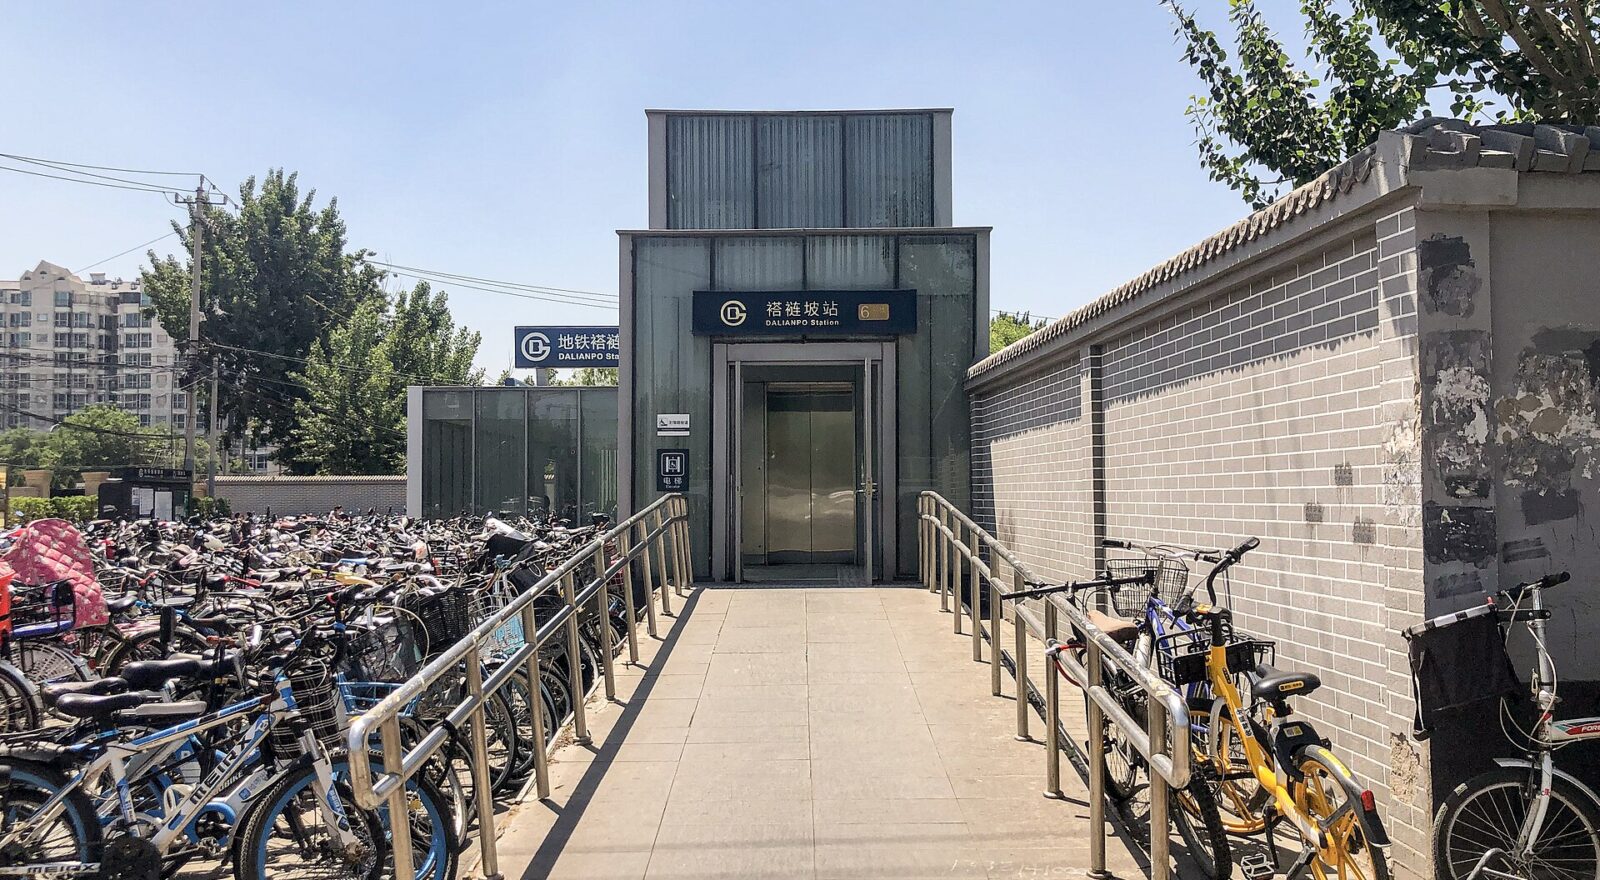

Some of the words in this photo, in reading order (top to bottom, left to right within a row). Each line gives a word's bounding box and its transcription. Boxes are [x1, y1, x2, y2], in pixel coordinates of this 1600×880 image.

[766, 301, 839, 318] 褡裢坡站
[860, 305, 870, 319] 6
[765, 319, 808, 327] DALIANPO
[810, 319, 840, 327] Station
[558, 352, 604, 360] DALIANPO
